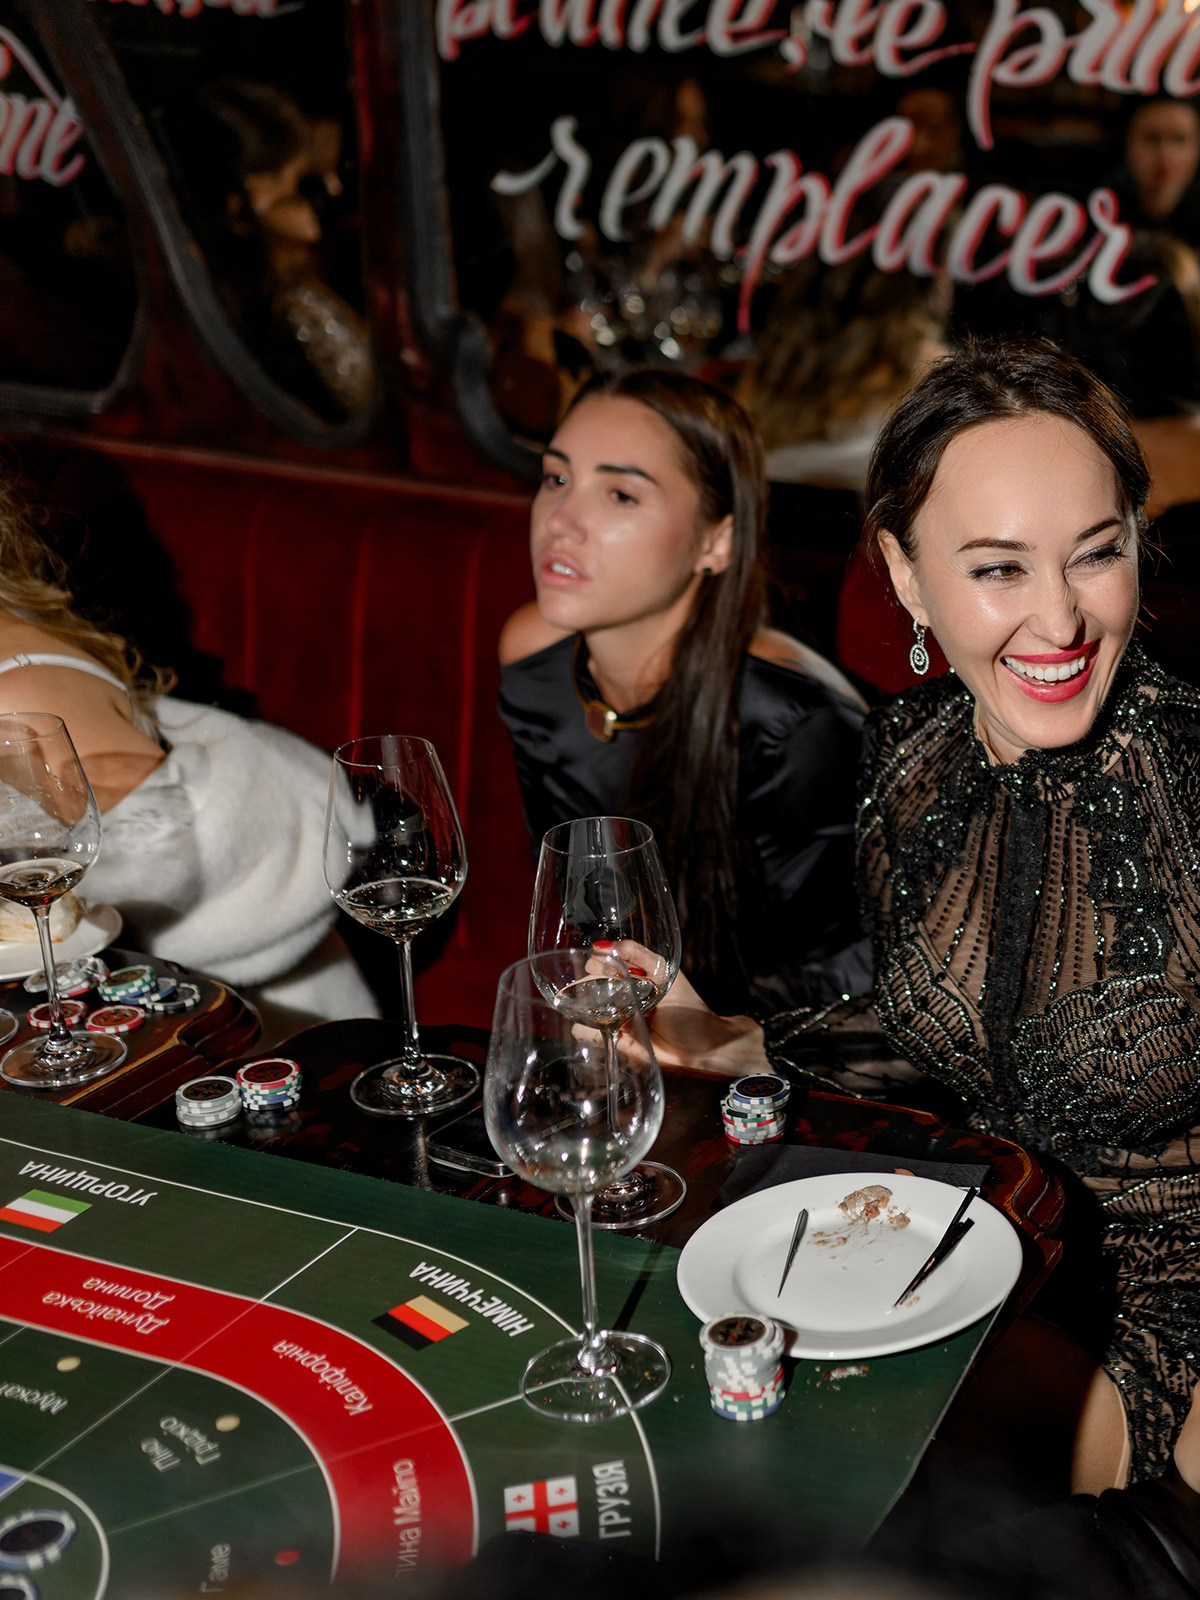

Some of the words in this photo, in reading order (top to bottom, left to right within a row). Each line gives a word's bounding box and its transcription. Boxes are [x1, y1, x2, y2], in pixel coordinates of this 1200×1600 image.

[490, 115, 1158, 332] remplacer
[18, 1161, 158, 1206] УГОРЩИНА
[42, 1290, 171, 1334] Дунайська
[82, 1276, 176, 1310] Долина
[409, 1261, 535, 1337] НІМЕЧЧИНА
[272, 1339, 374, 1416] Каліфорнія
[592, 1459, 631, 1539] ГРУЗІЯ
